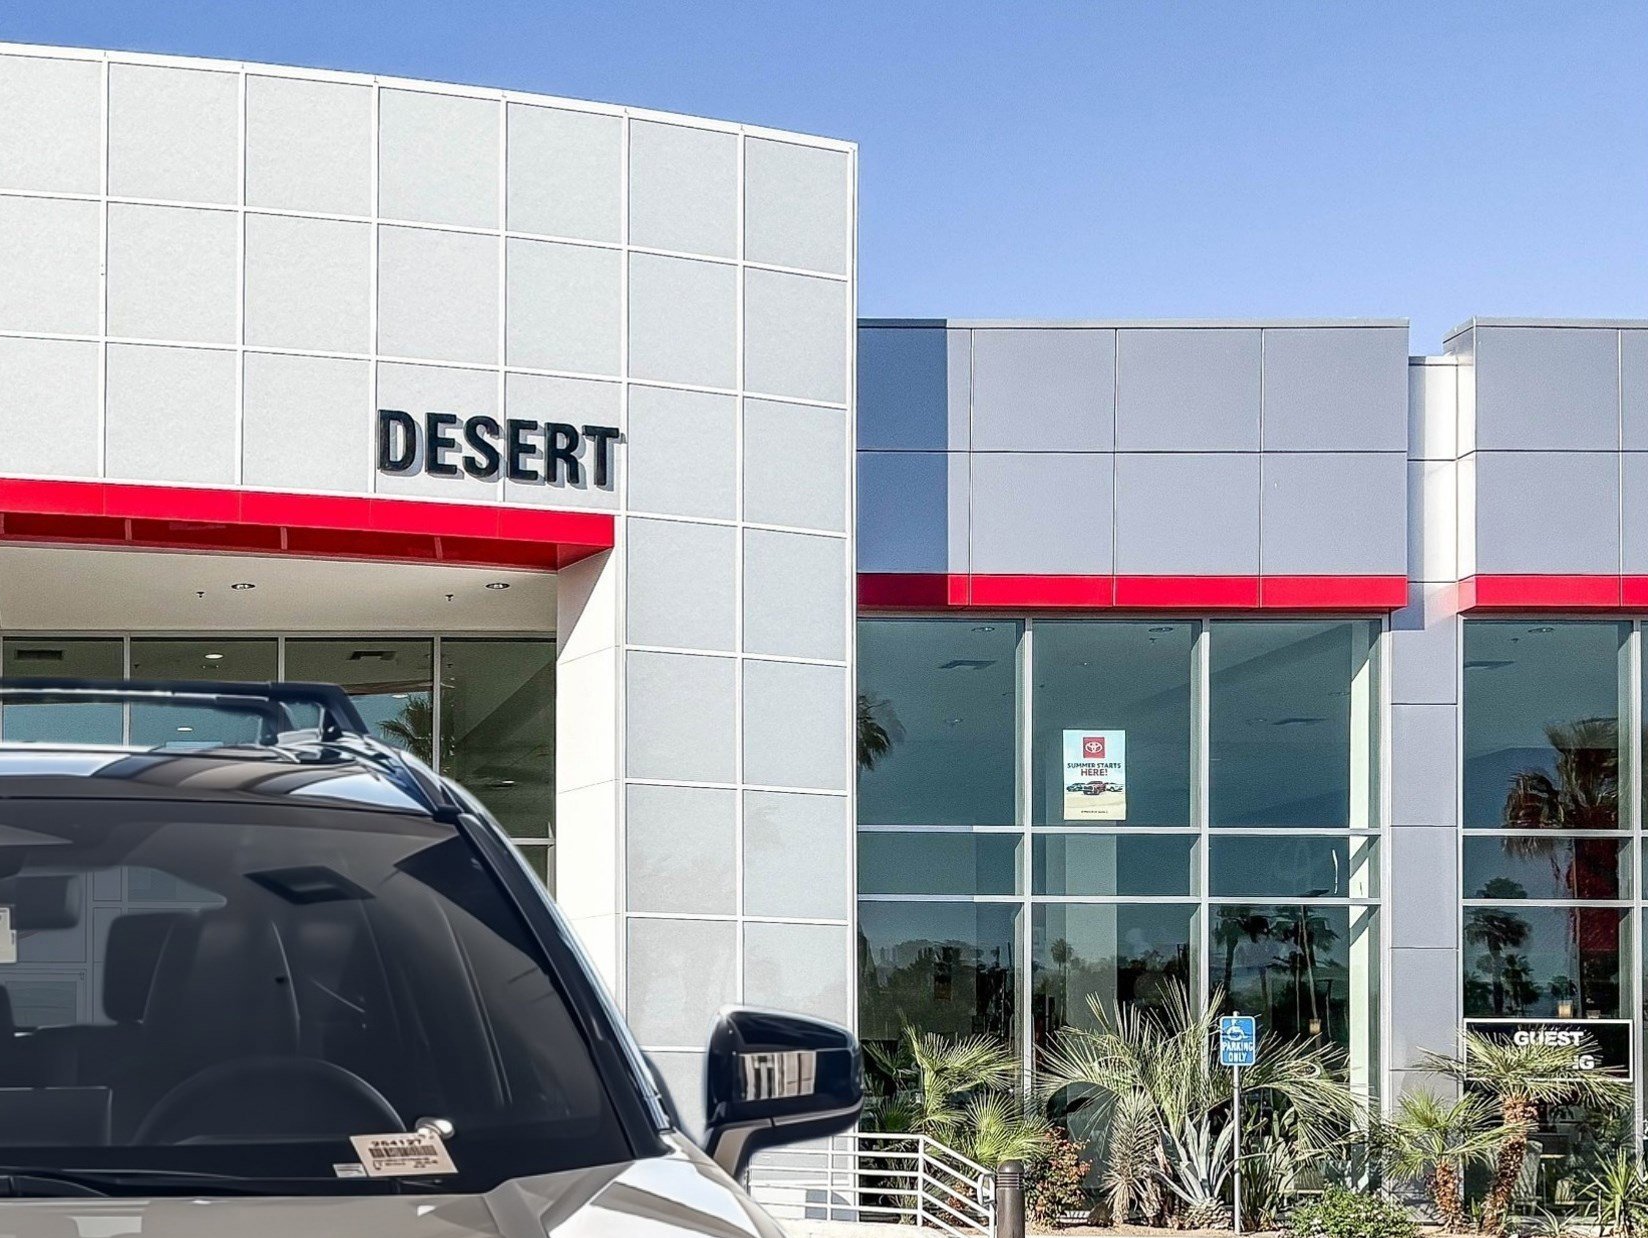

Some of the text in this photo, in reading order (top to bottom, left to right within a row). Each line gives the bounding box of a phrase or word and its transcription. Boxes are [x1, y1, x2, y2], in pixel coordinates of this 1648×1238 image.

[377, 409, 620, 487] DESERT
[1080, 768, 1108, 777] HERE!
[1513, 1030, 1584, 1046] GUEST
[1223, 1042, 1254, 1052] PARKING
[1228, 1052, 1247, 1062] ONLY
